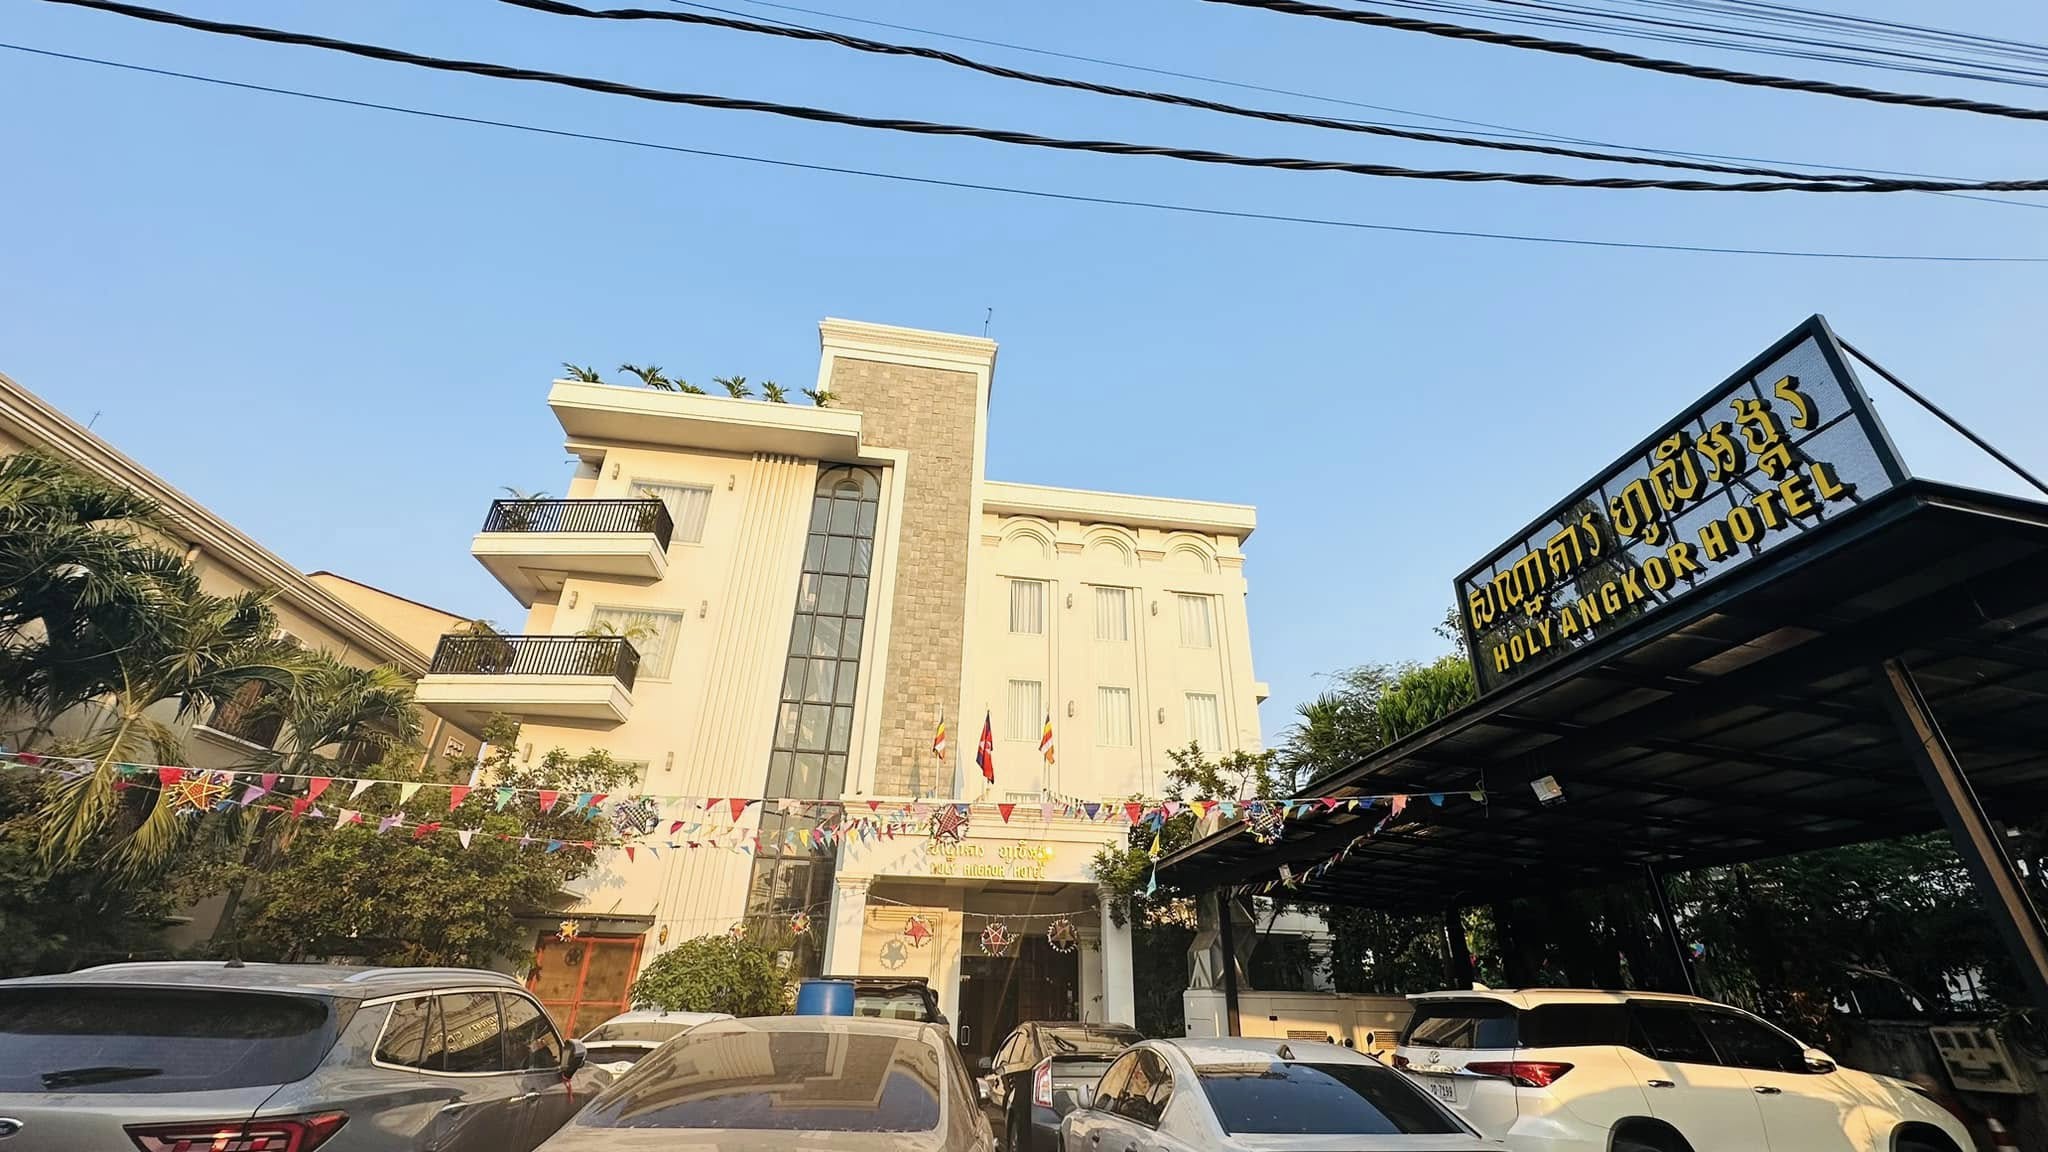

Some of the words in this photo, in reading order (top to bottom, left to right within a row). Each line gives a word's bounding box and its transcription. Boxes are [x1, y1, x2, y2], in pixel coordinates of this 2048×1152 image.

[1493, 618, 1551, 673] HOLY
[1561, 541, 1700, 639] ANGKOR
[1698, 462, 1847, 561] HOTEL
[963, 863, 1006, 877] ANGKOR
